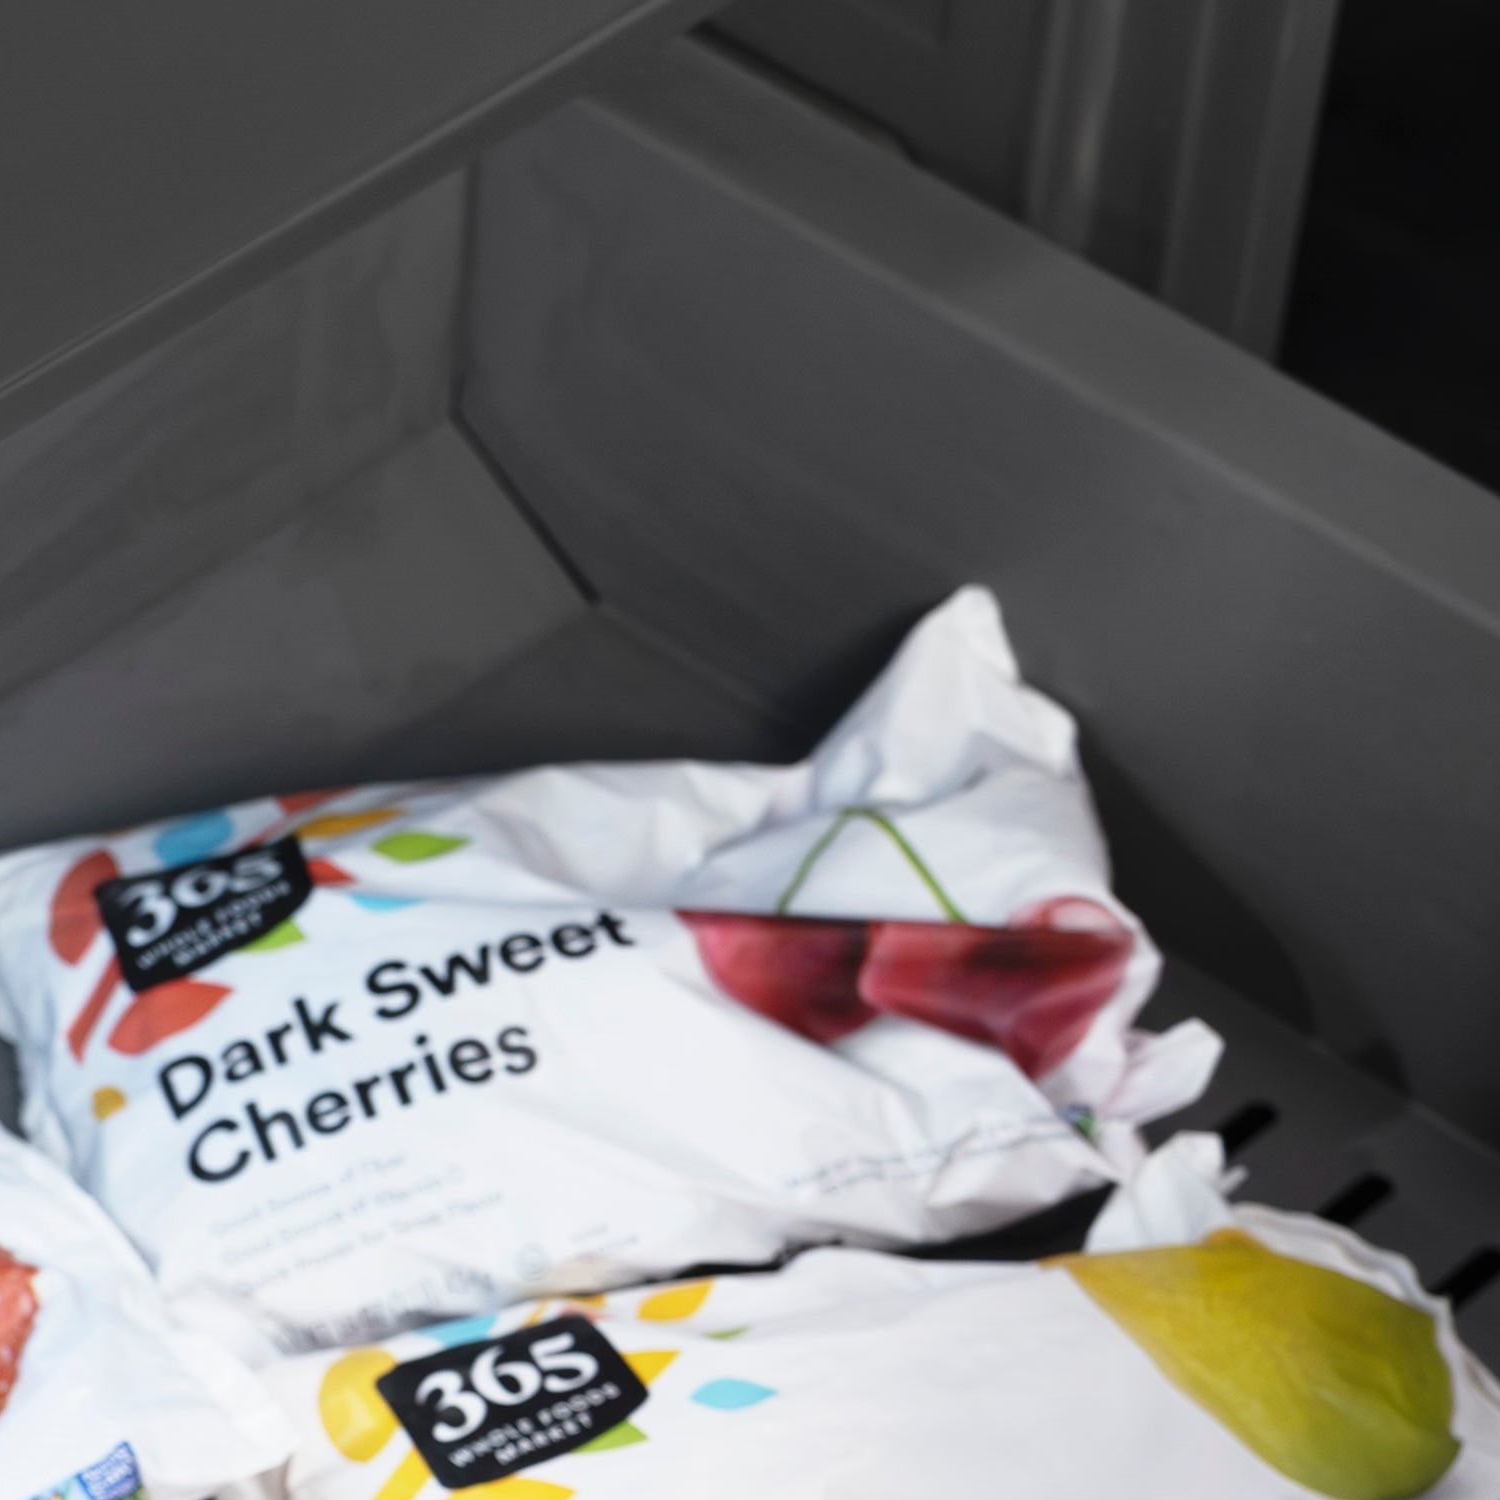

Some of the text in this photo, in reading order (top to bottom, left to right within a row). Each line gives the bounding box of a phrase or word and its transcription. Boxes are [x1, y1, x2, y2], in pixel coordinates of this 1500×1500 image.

[158, 908, 636, 1120] Dark Sweet
[187, 1026, 538, 1183] Cherries
[415, 1332, 599, 1442] 365
